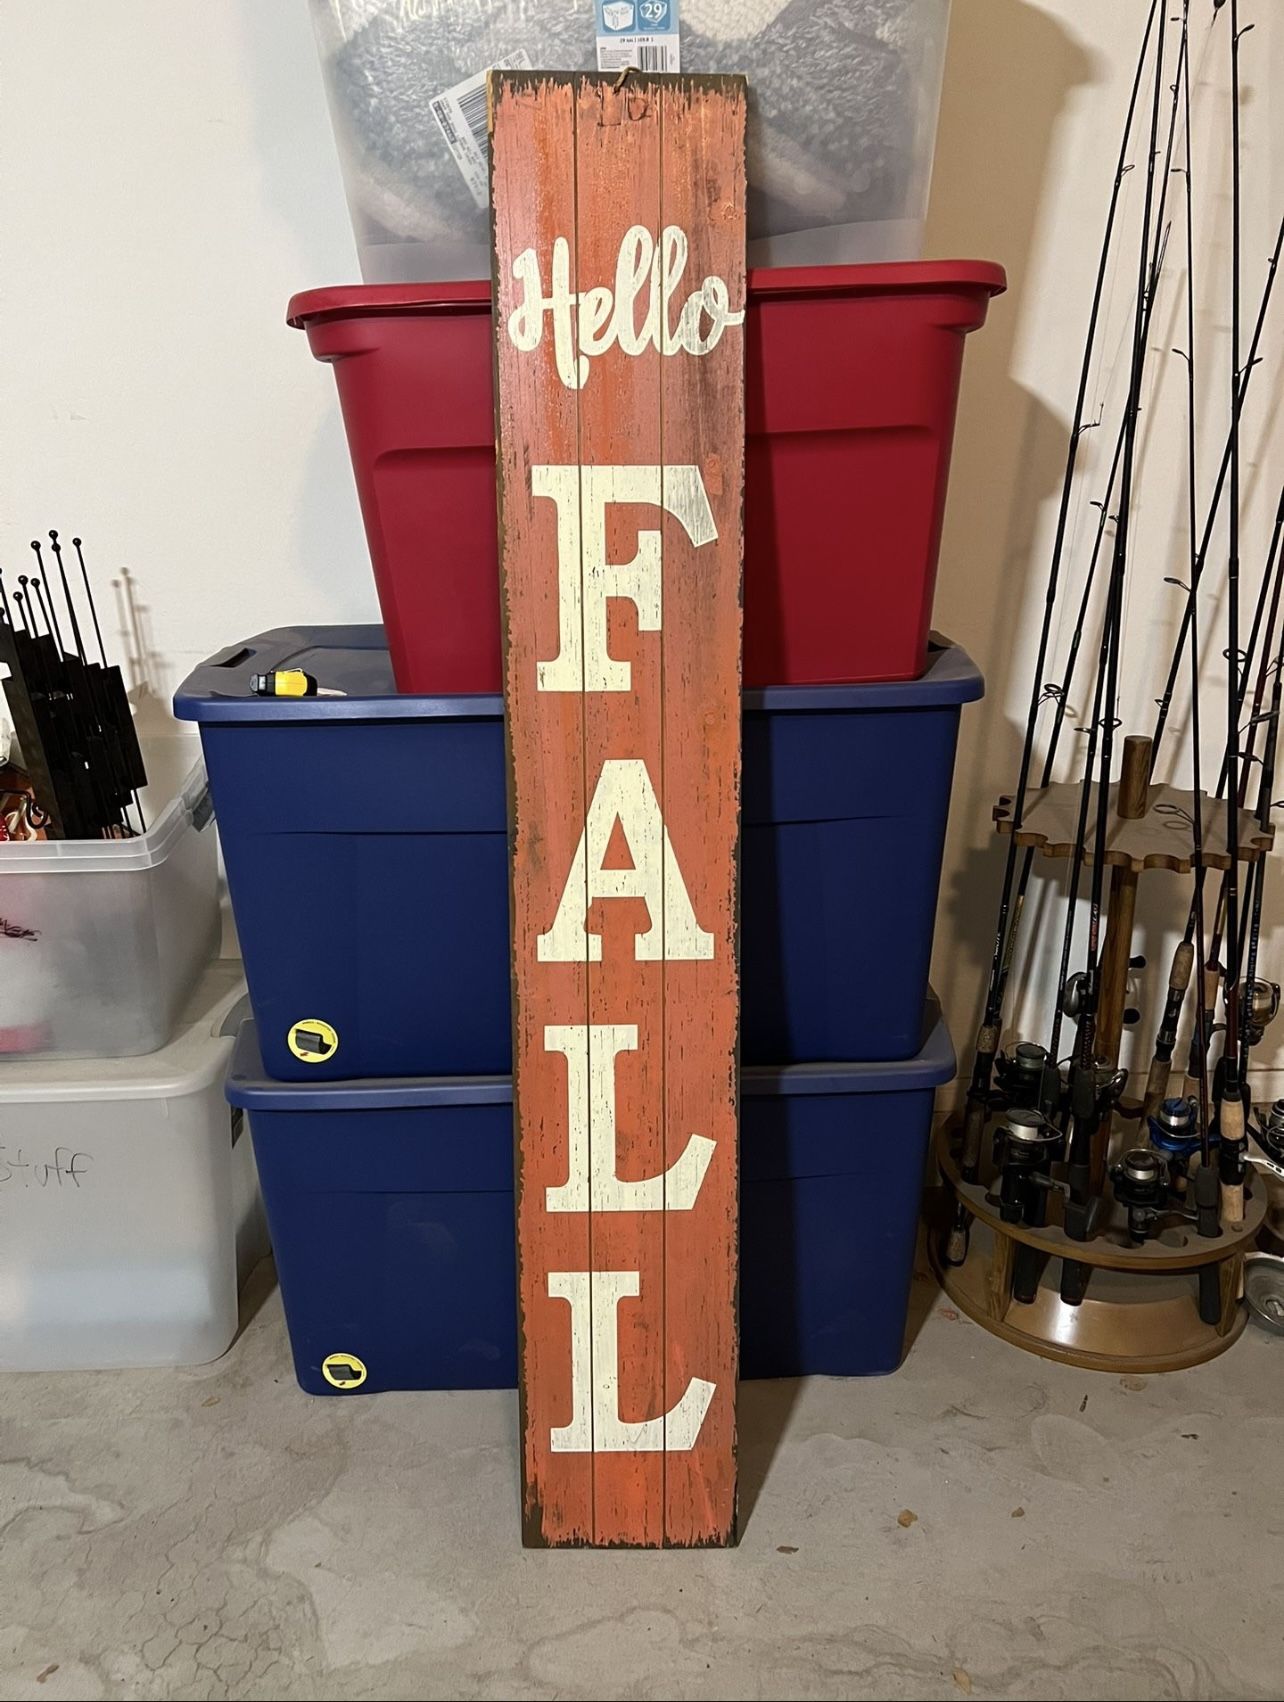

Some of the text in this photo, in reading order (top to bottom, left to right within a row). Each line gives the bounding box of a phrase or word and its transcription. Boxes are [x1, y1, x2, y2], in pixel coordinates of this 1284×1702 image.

[645, 3, 662, 18] 29
[508, 225, 745, 389] Hello
[531, 465, 719, 1452] FALL
